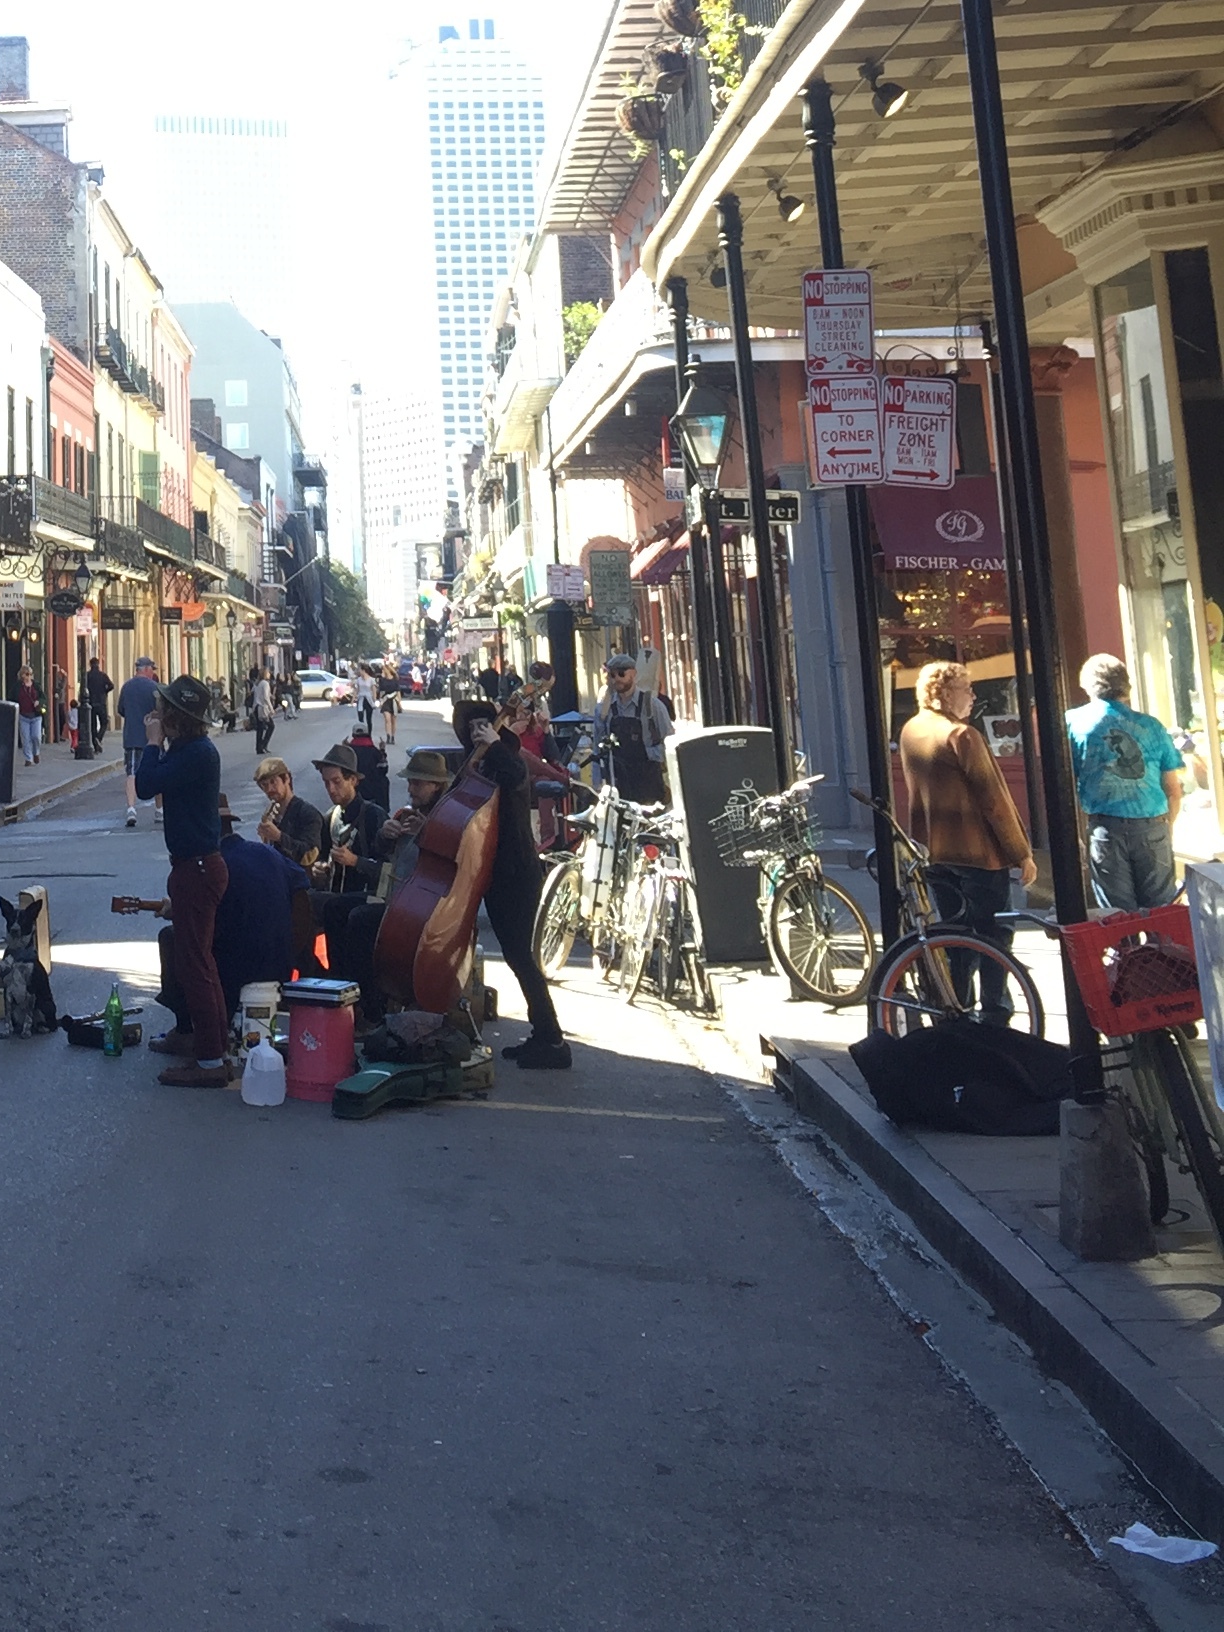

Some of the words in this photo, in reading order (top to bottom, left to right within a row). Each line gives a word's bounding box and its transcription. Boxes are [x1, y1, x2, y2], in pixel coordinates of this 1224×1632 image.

[804, 279, 823, 299] NO
[824, 282, 868, 295] STOPPING
[842, 308, 865, 319] NOON
[816, 321, 862, 331] THURSDAY
[821, 332, 858, 341] STREET
[814, 341, 865, 352] CLEANING
[811, 386, 830, 406] NO
[831, 387, 876, 402] STOPPING
[885, 385, 904, 406] NO
[905, 389, 952, 406] PARKING
[837, 415, 854, 426] TO
[888, 415, 947, 432] FREIGHT
[820, 429, 874, 443] CORNER
[898, 432, 936, 448] ZONE
[821, 462, 879, 477] ANYTIME
[895, 556, 959, 569] FISCHER
